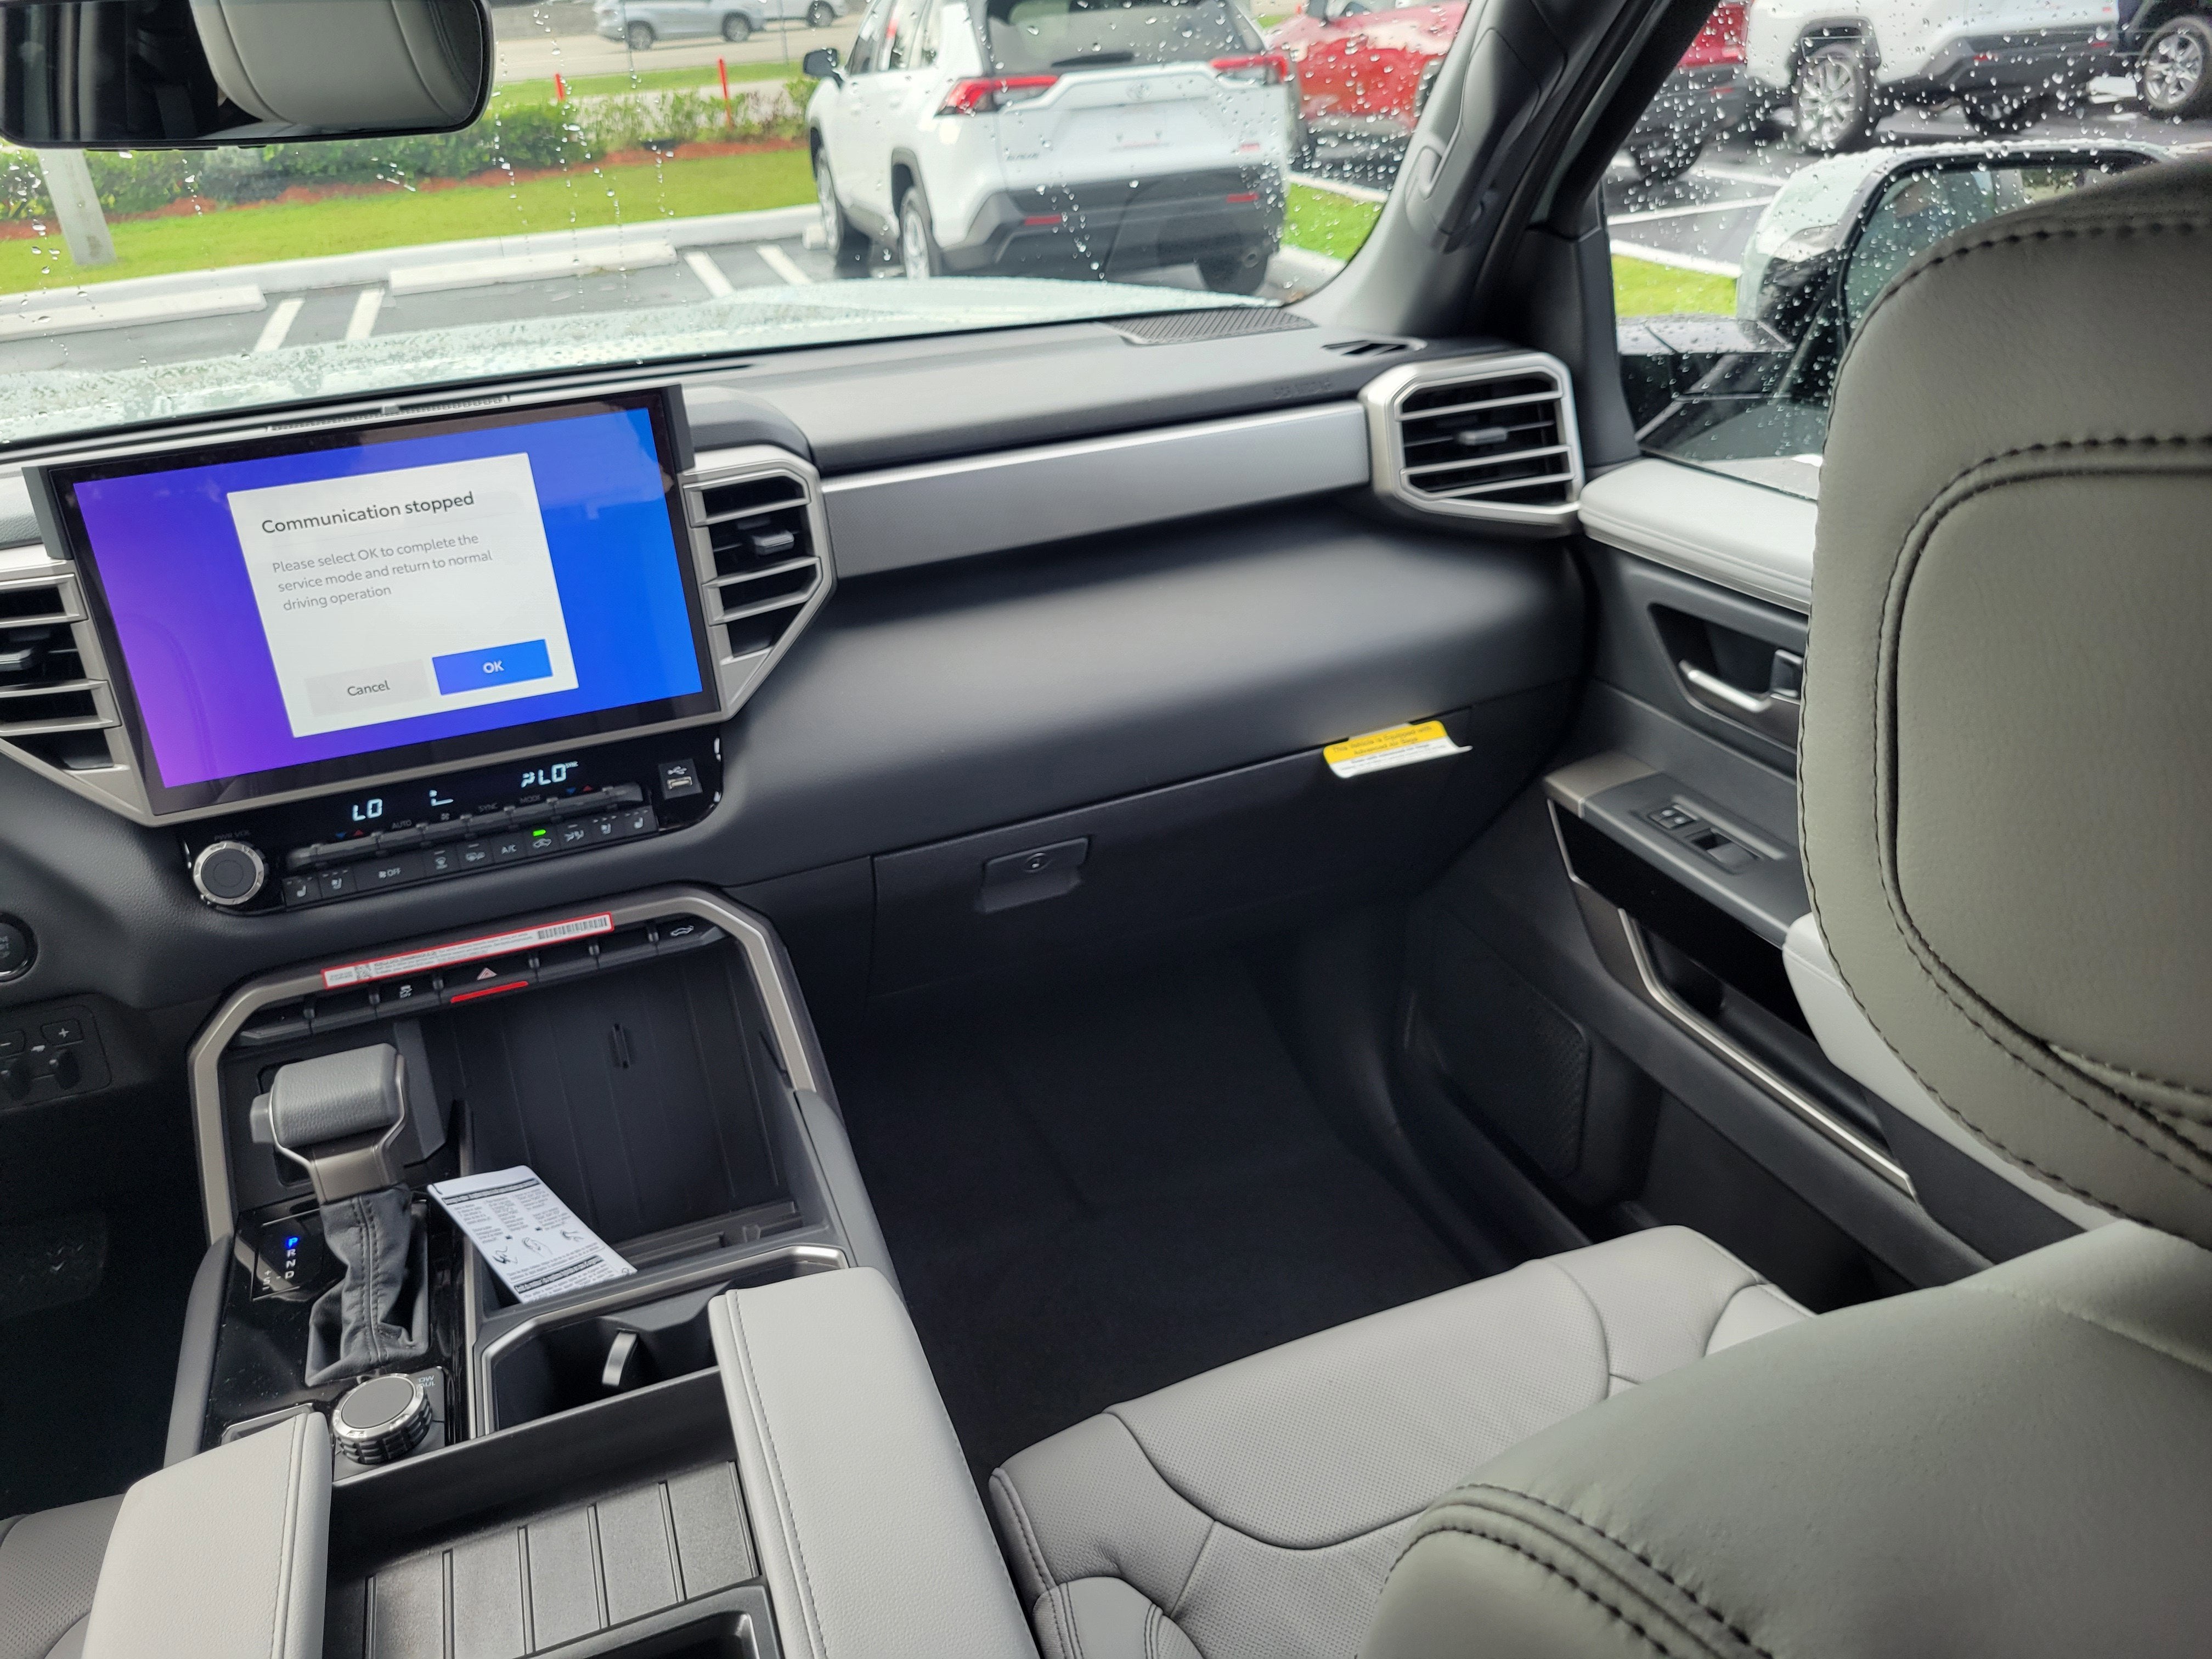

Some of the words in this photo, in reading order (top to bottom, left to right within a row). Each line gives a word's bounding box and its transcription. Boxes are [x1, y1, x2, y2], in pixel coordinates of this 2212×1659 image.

[262, 503, 401, 534] Communication
[405, 490, 475, 517] stopped
[272, 557, 315, 574] Please
[318, 551, 356, 568] select
[358, 547, 379, 560] OK
[380, 546, 394, 558] to
[397, 535, 456, 558] complete
[458, 533, 480, 547] the
[278, 576, 323, 592] service
[325, 568, 363, 585] mode
[365, 564, 390, 579] and
[392, 559, 431, 575] return
[432, 556, 446, 568] to
[448, 549, 493, 566] normal
[283, 594, 328, 612] driving
[330, 584, 392, 607] operation
[483, 659, 505, 675] OK
[347, 679, 391, 697] Cancel
[386, 867, 402, 877] OFF
[288, 1237, 298, 1246] P
[287, 1248, 296, 1257] R
[286, 1259, 296, 1267] N
[285, 1271, 295, 1279] D
